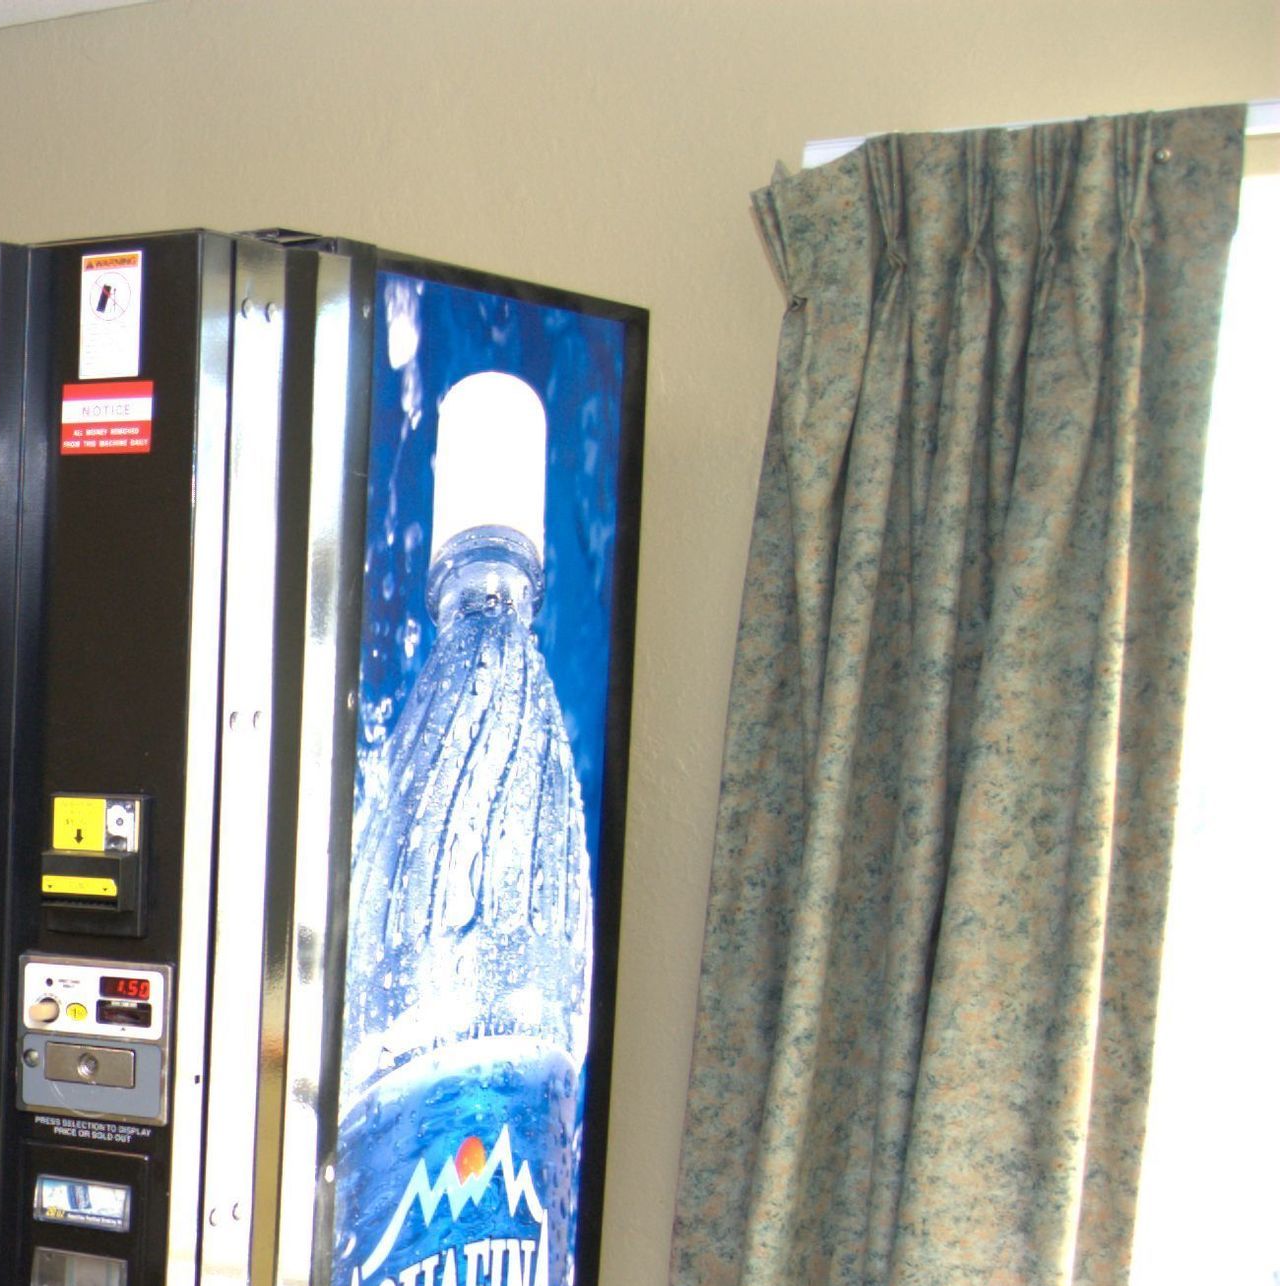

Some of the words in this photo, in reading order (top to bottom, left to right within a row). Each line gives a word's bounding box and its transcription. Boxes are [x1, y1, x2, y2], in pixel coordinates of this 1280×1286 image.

[82, 404, 131, 416] NOTICE
[35, 1116, 60, 1126] PRESS
[61, 1118, 105, 1132] SELECTION
[118, 1125, 151, 1137] DISPLAY
[54, 1127, 77, 1137] PRICE
